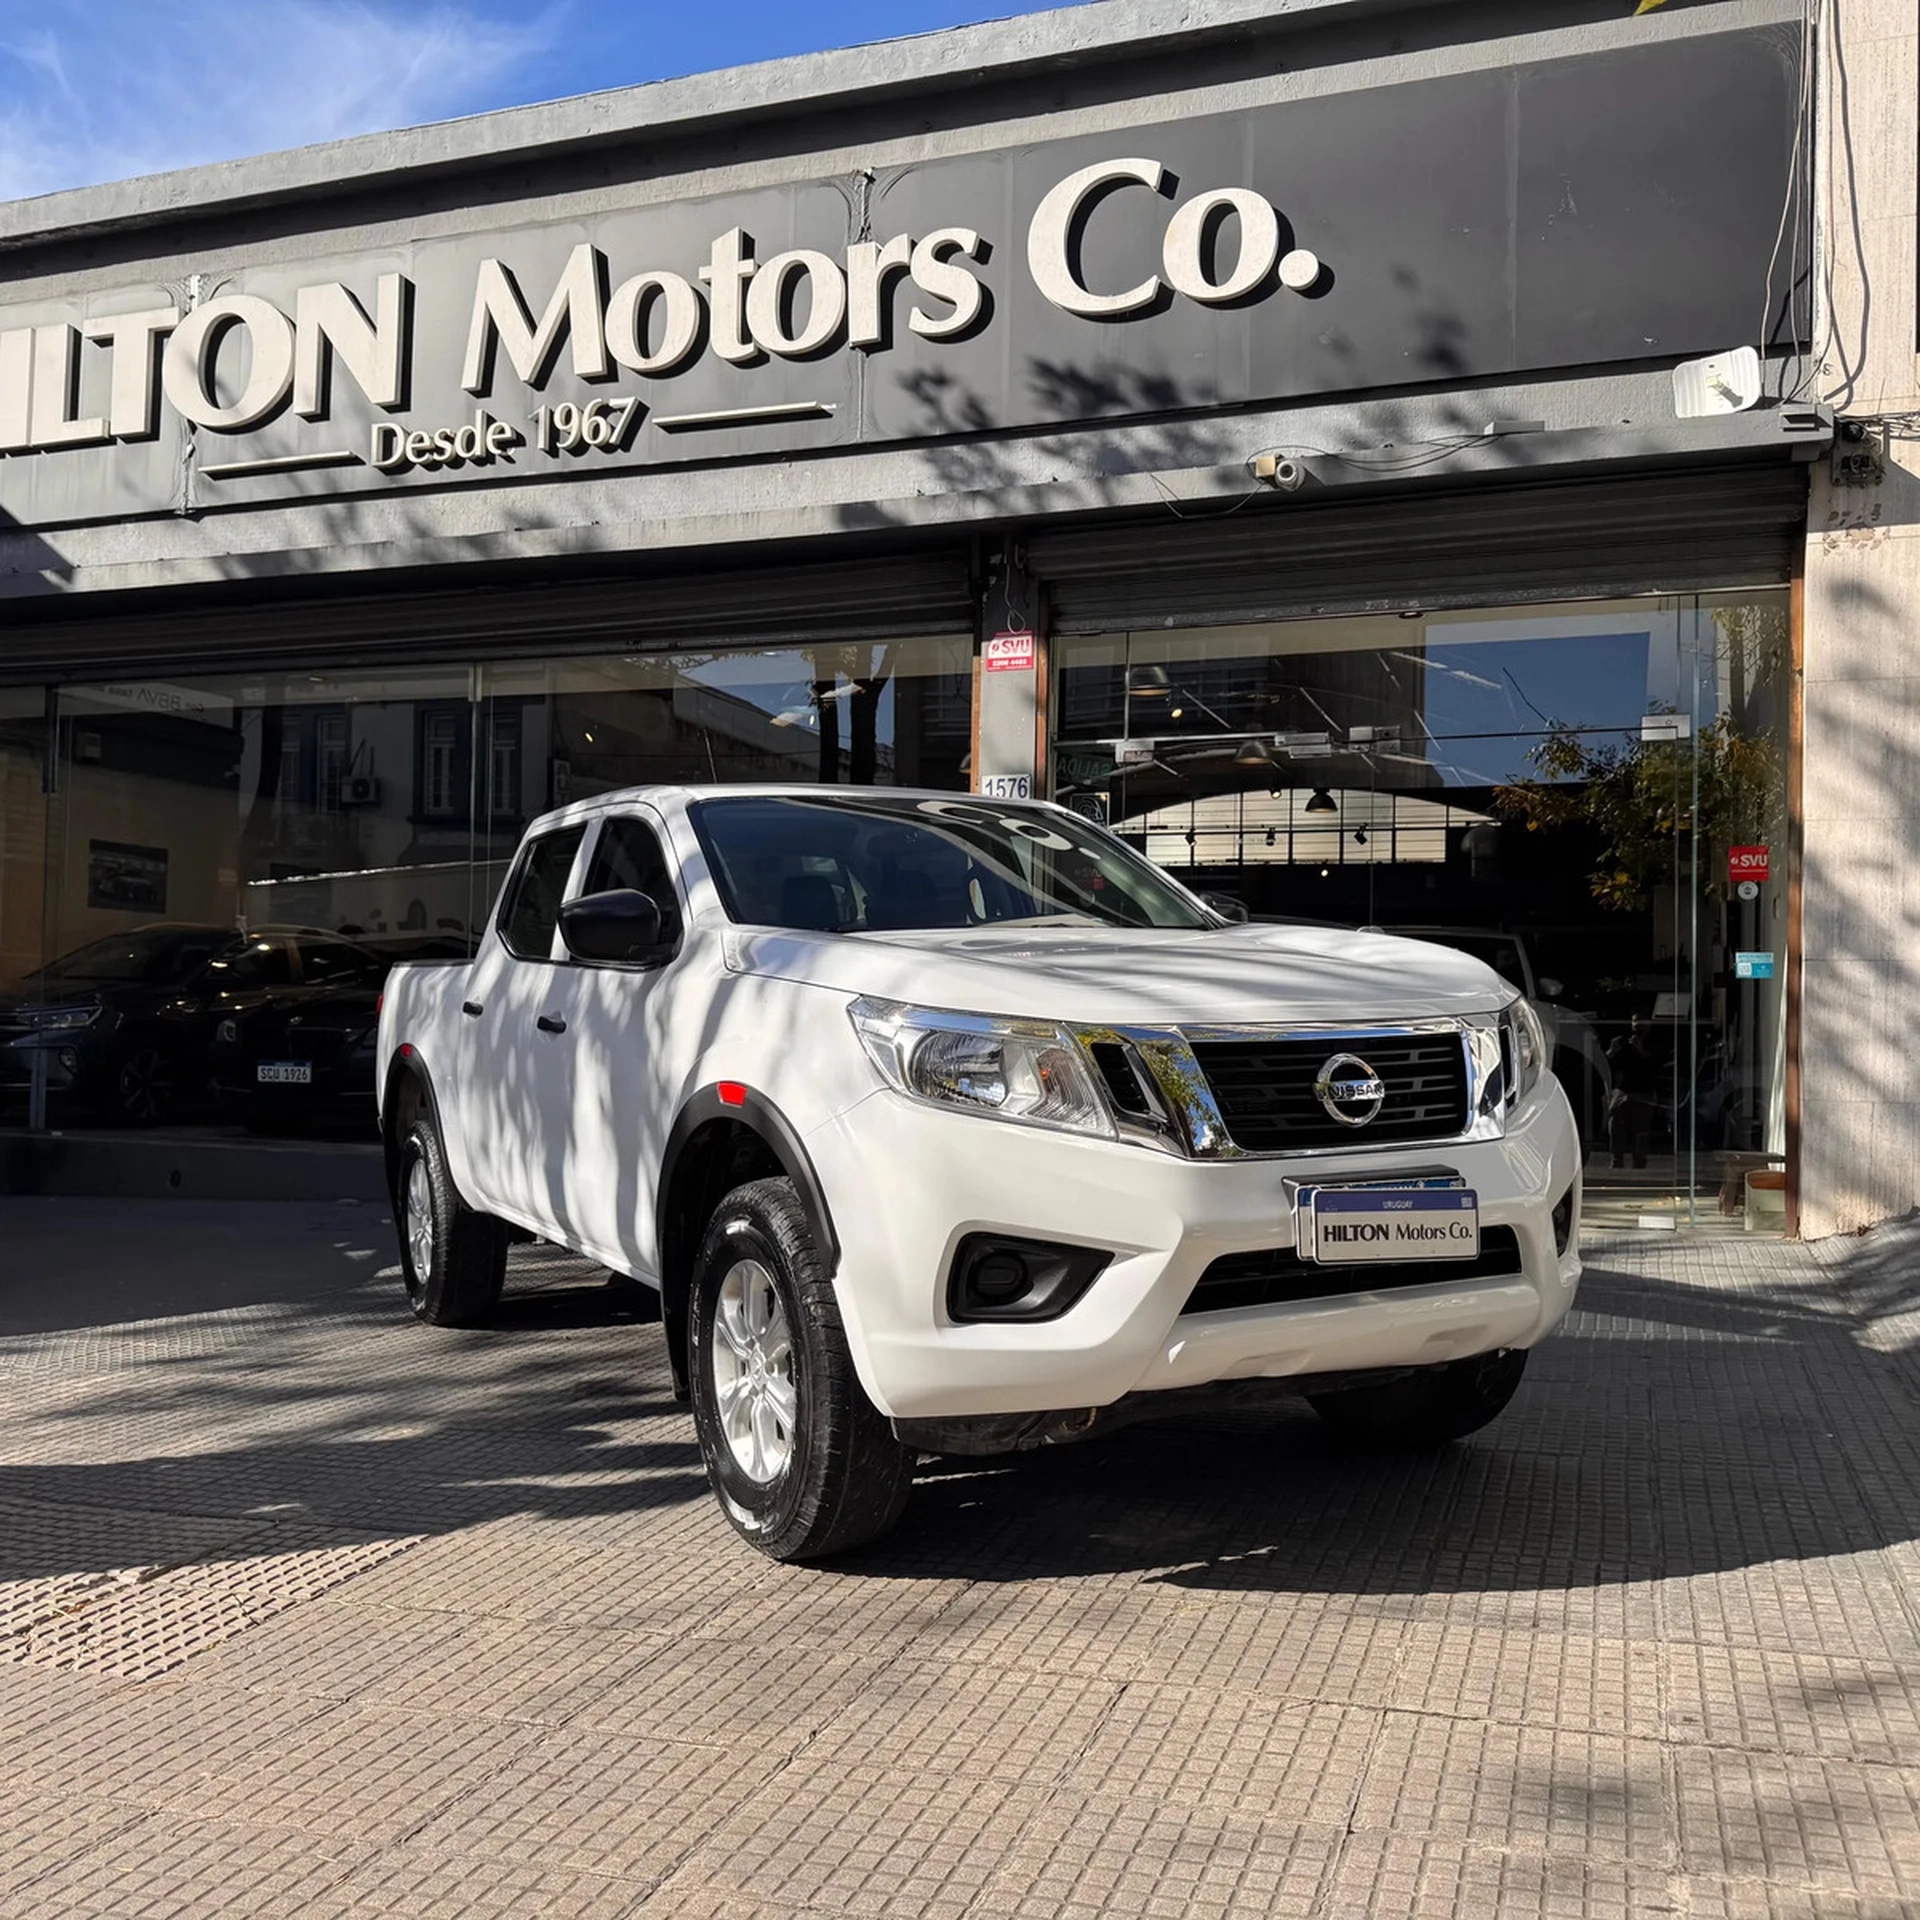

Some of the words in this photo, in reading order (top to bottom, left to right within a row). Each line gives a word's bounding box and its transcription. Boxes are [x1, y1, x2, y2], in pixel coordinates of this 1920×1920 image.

[0, 273, 406, 446] ILTON
[461, 226, 983, 393] Motors
[1027, 158, 1321, 316] Co.
[371, 408, 517, 469] Desde
[527, 396, 640, 451] 1967
[1001, 639, 1029, 654] SVU
[984, 776, 1028, 798] 1576
[1740, 854, 1768, 867] SVU
[283, 1068, 308, 1081] 1926
[1327, 1083, 1382, 1098] NISSAN
[1323, 1223, 1390, 1242] HILTON
[1395, 1224, 1446, 1241] Motors
[1449, 1221, 1473, 1239] Co.
